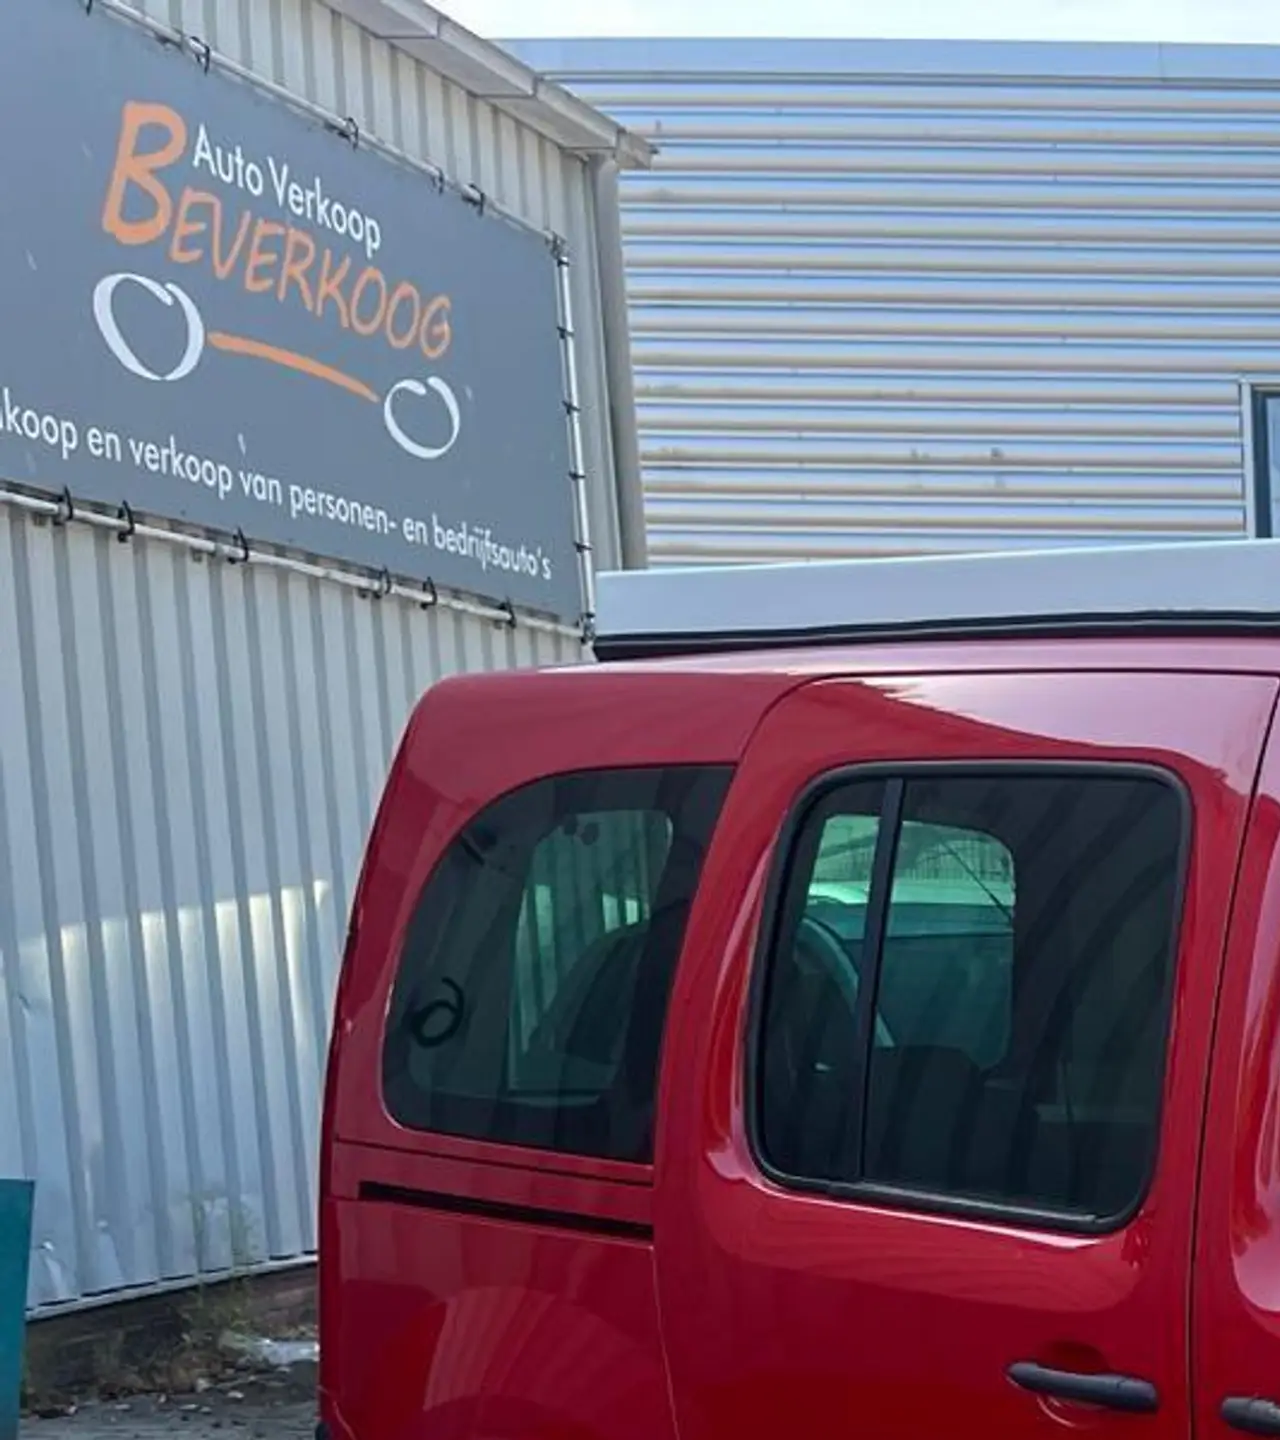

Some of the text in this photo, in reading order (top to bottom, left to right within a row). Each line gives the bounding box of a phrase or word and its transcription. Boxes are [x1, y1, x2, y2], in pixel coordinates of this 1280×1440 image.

[102, 100, 452, 359] BEVERKOOG
[190, 123, 381, 259] Auto Verkoop
[0, 386, 552, 581] koop en verkoop van personen- en bedrijfsauto's
